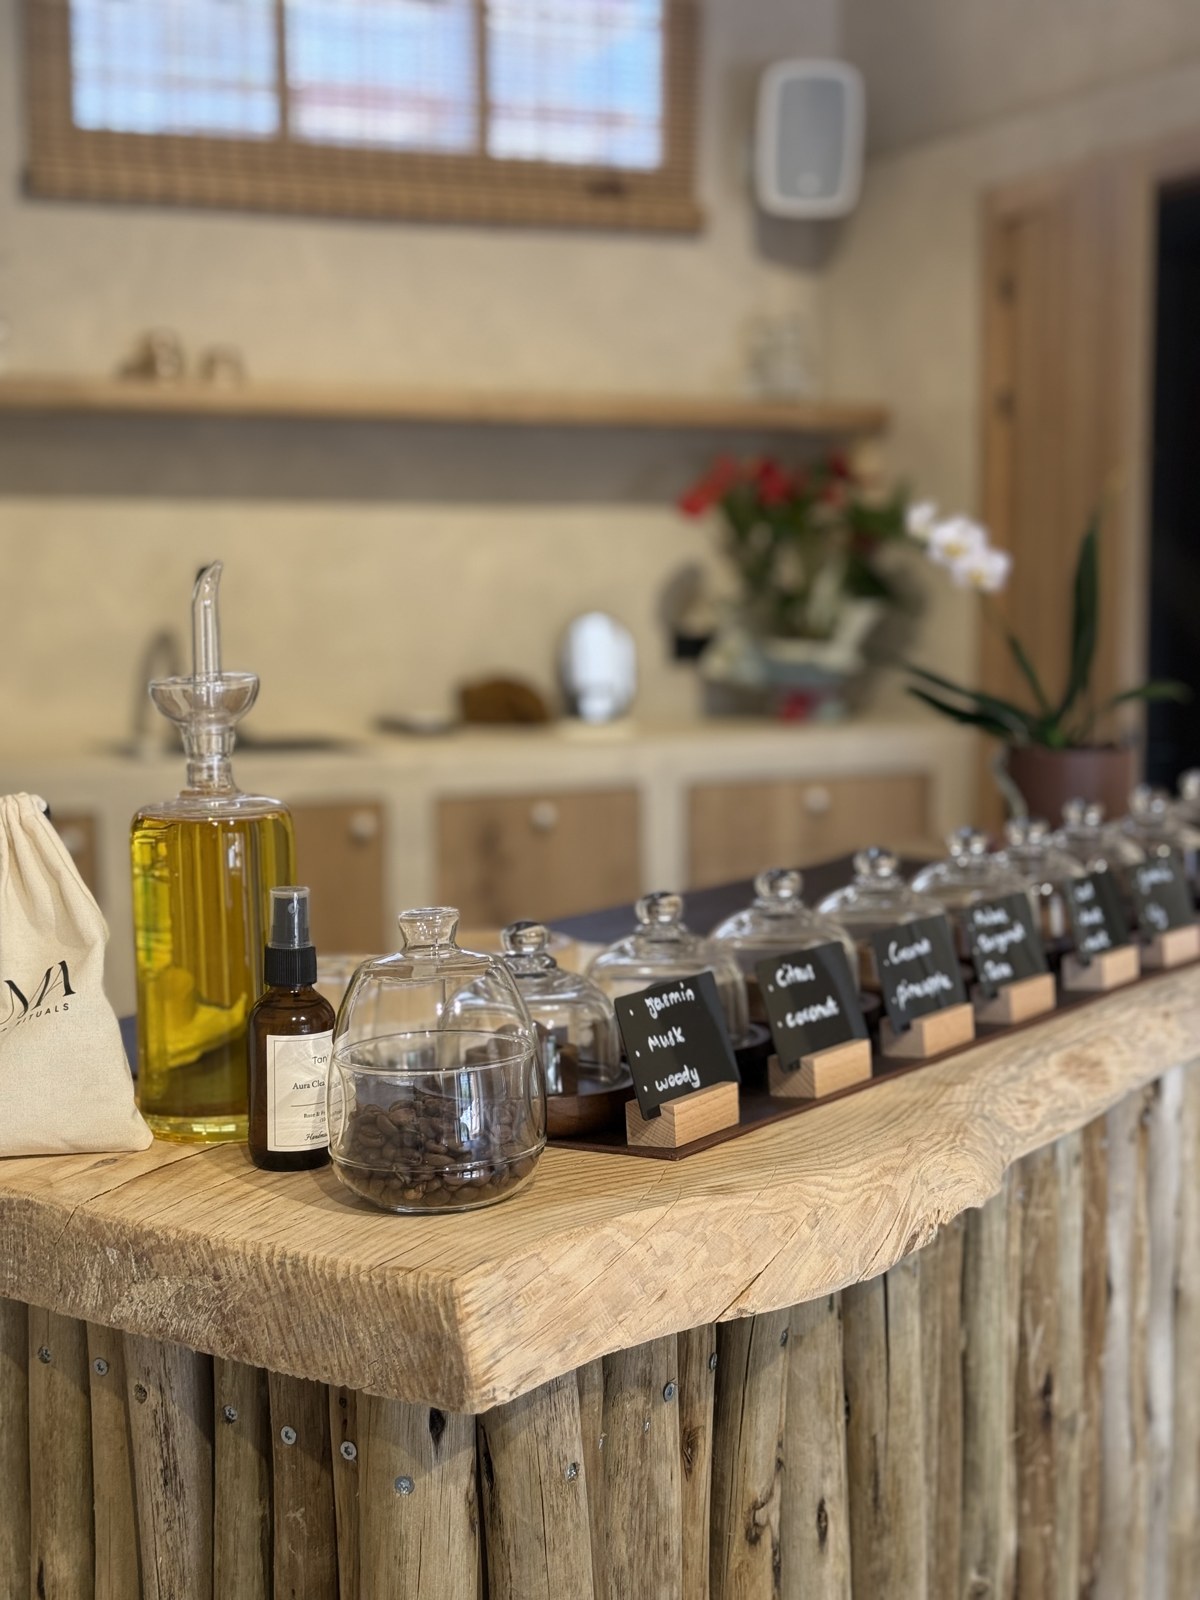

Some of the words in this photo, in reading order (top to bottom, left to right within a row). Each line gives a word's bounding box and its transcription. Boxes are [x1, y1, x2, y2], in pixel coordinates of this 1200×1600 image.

[292, 1082, 311, 1090] Aura
[311, 1079, 326, 1088] Clea
[655, 1064, 701, 1092] woody
